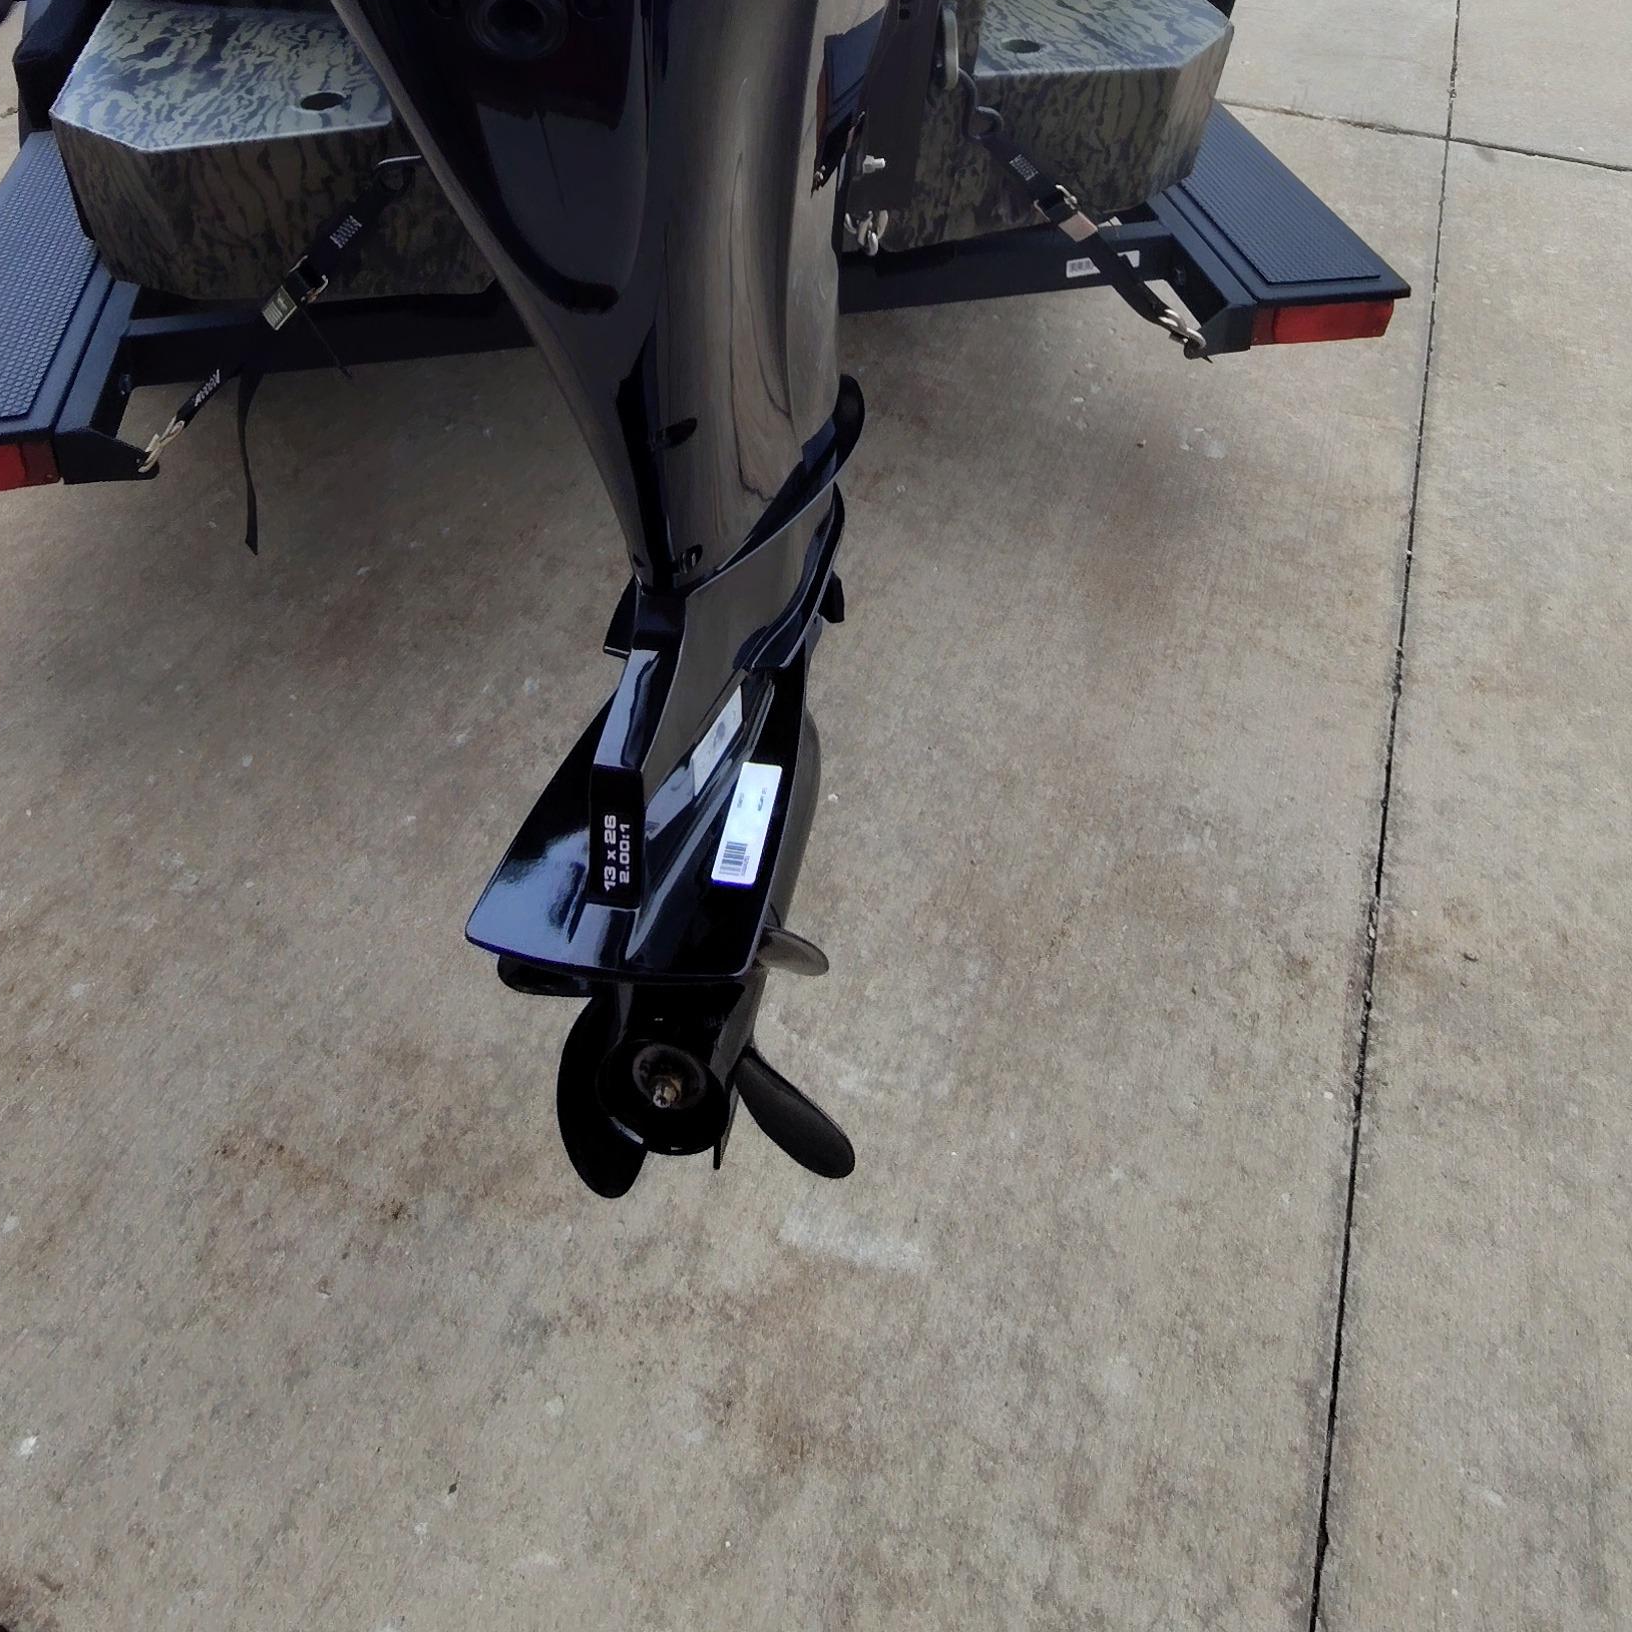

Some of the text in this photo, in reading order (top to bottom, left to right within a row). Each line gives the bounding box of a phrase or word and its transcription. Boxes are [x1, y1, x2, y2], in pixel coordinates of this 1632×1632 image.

[604, 814, 617, 891] 13 x 26
[619, 823, 630, 884] 2.00:1
